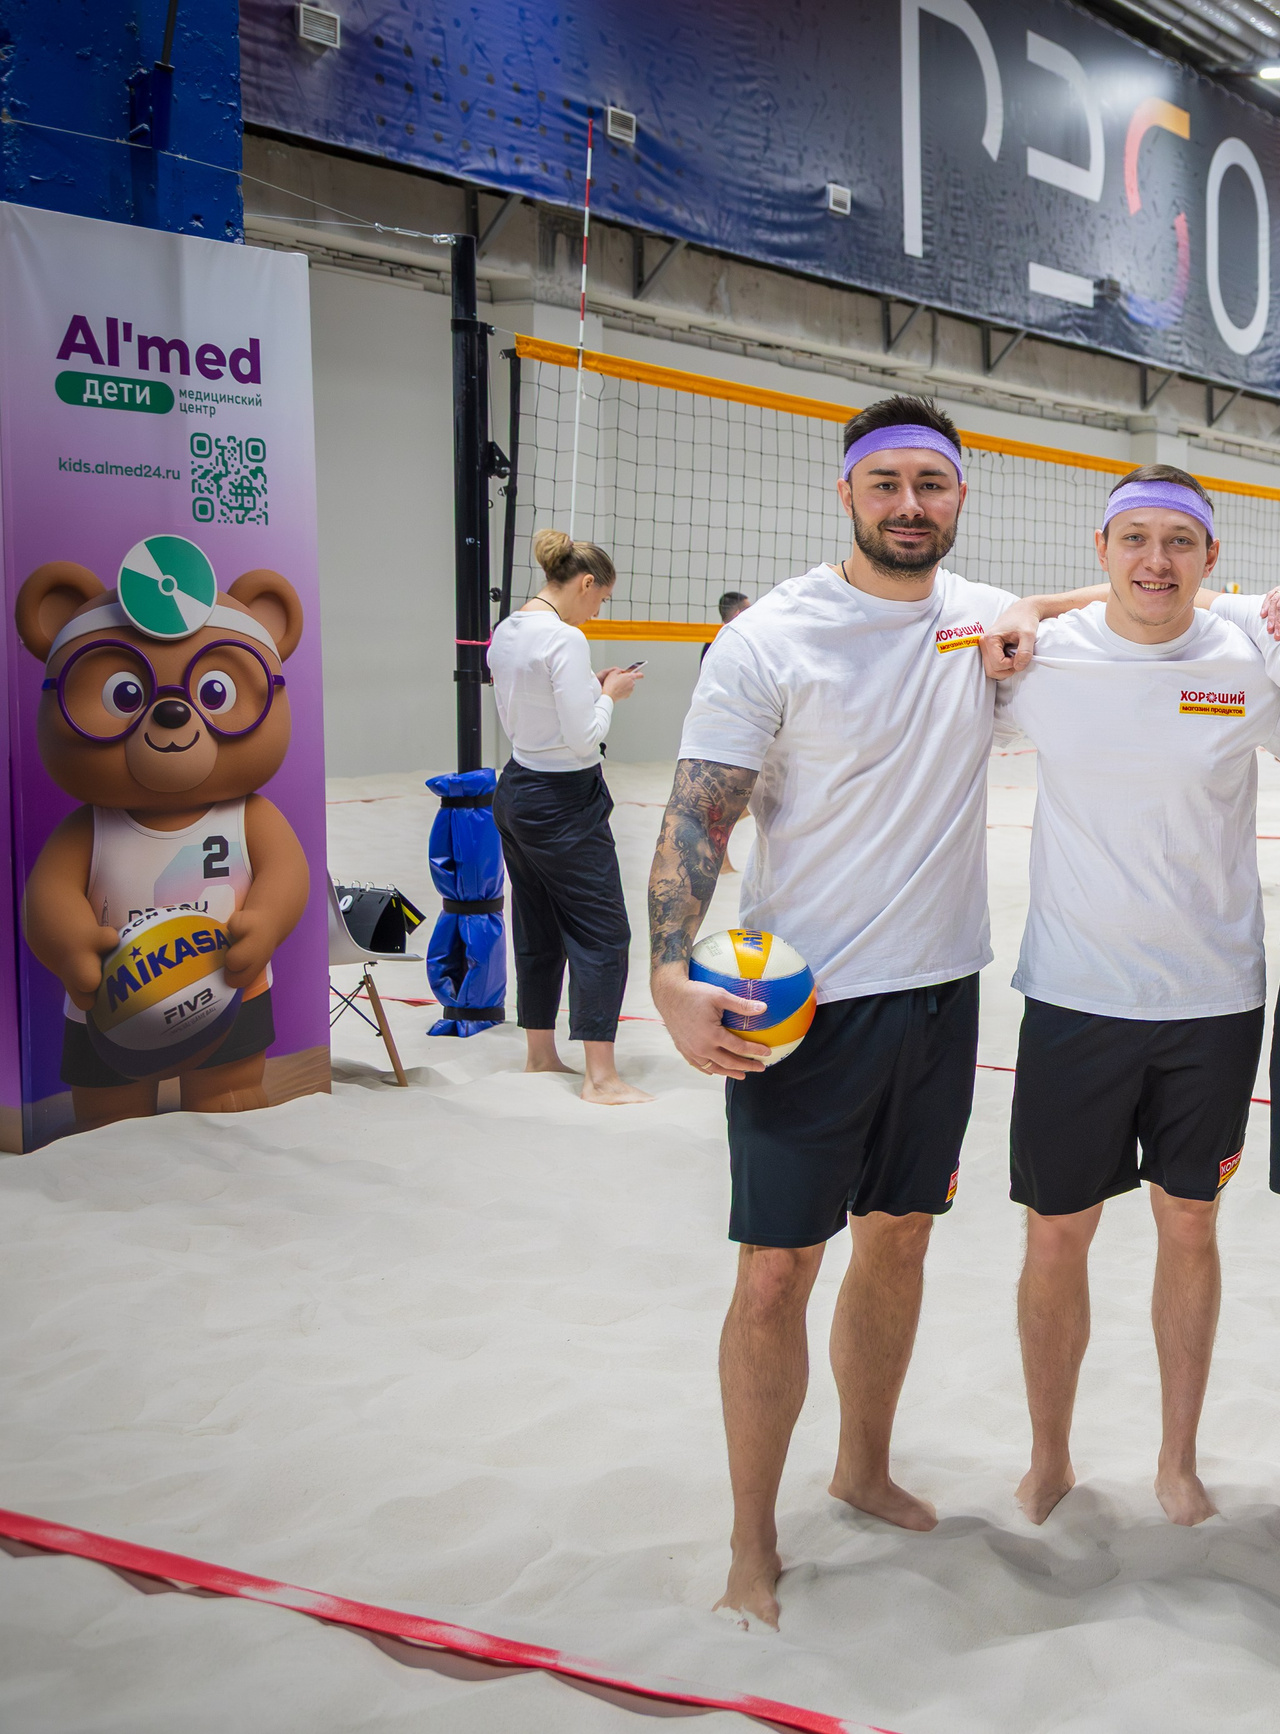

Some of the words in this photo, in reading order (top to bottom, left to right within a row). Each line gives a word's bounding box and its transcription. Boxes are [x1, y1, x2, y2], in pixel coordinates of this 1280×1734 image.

[56, 314, 262, 385] Al'med
[83, 379, 151, 406] дети
[179, 388, 263, 408] медицинский
[179, 402, 216, 419] центр
[58, 457, 181, 480] kids.almed24.ru
[1180, 690, 1245, 705] ХОРОШИЙ
[1182, 705, 1210, 713] магазин
[203, 835, 230, 879] 2
